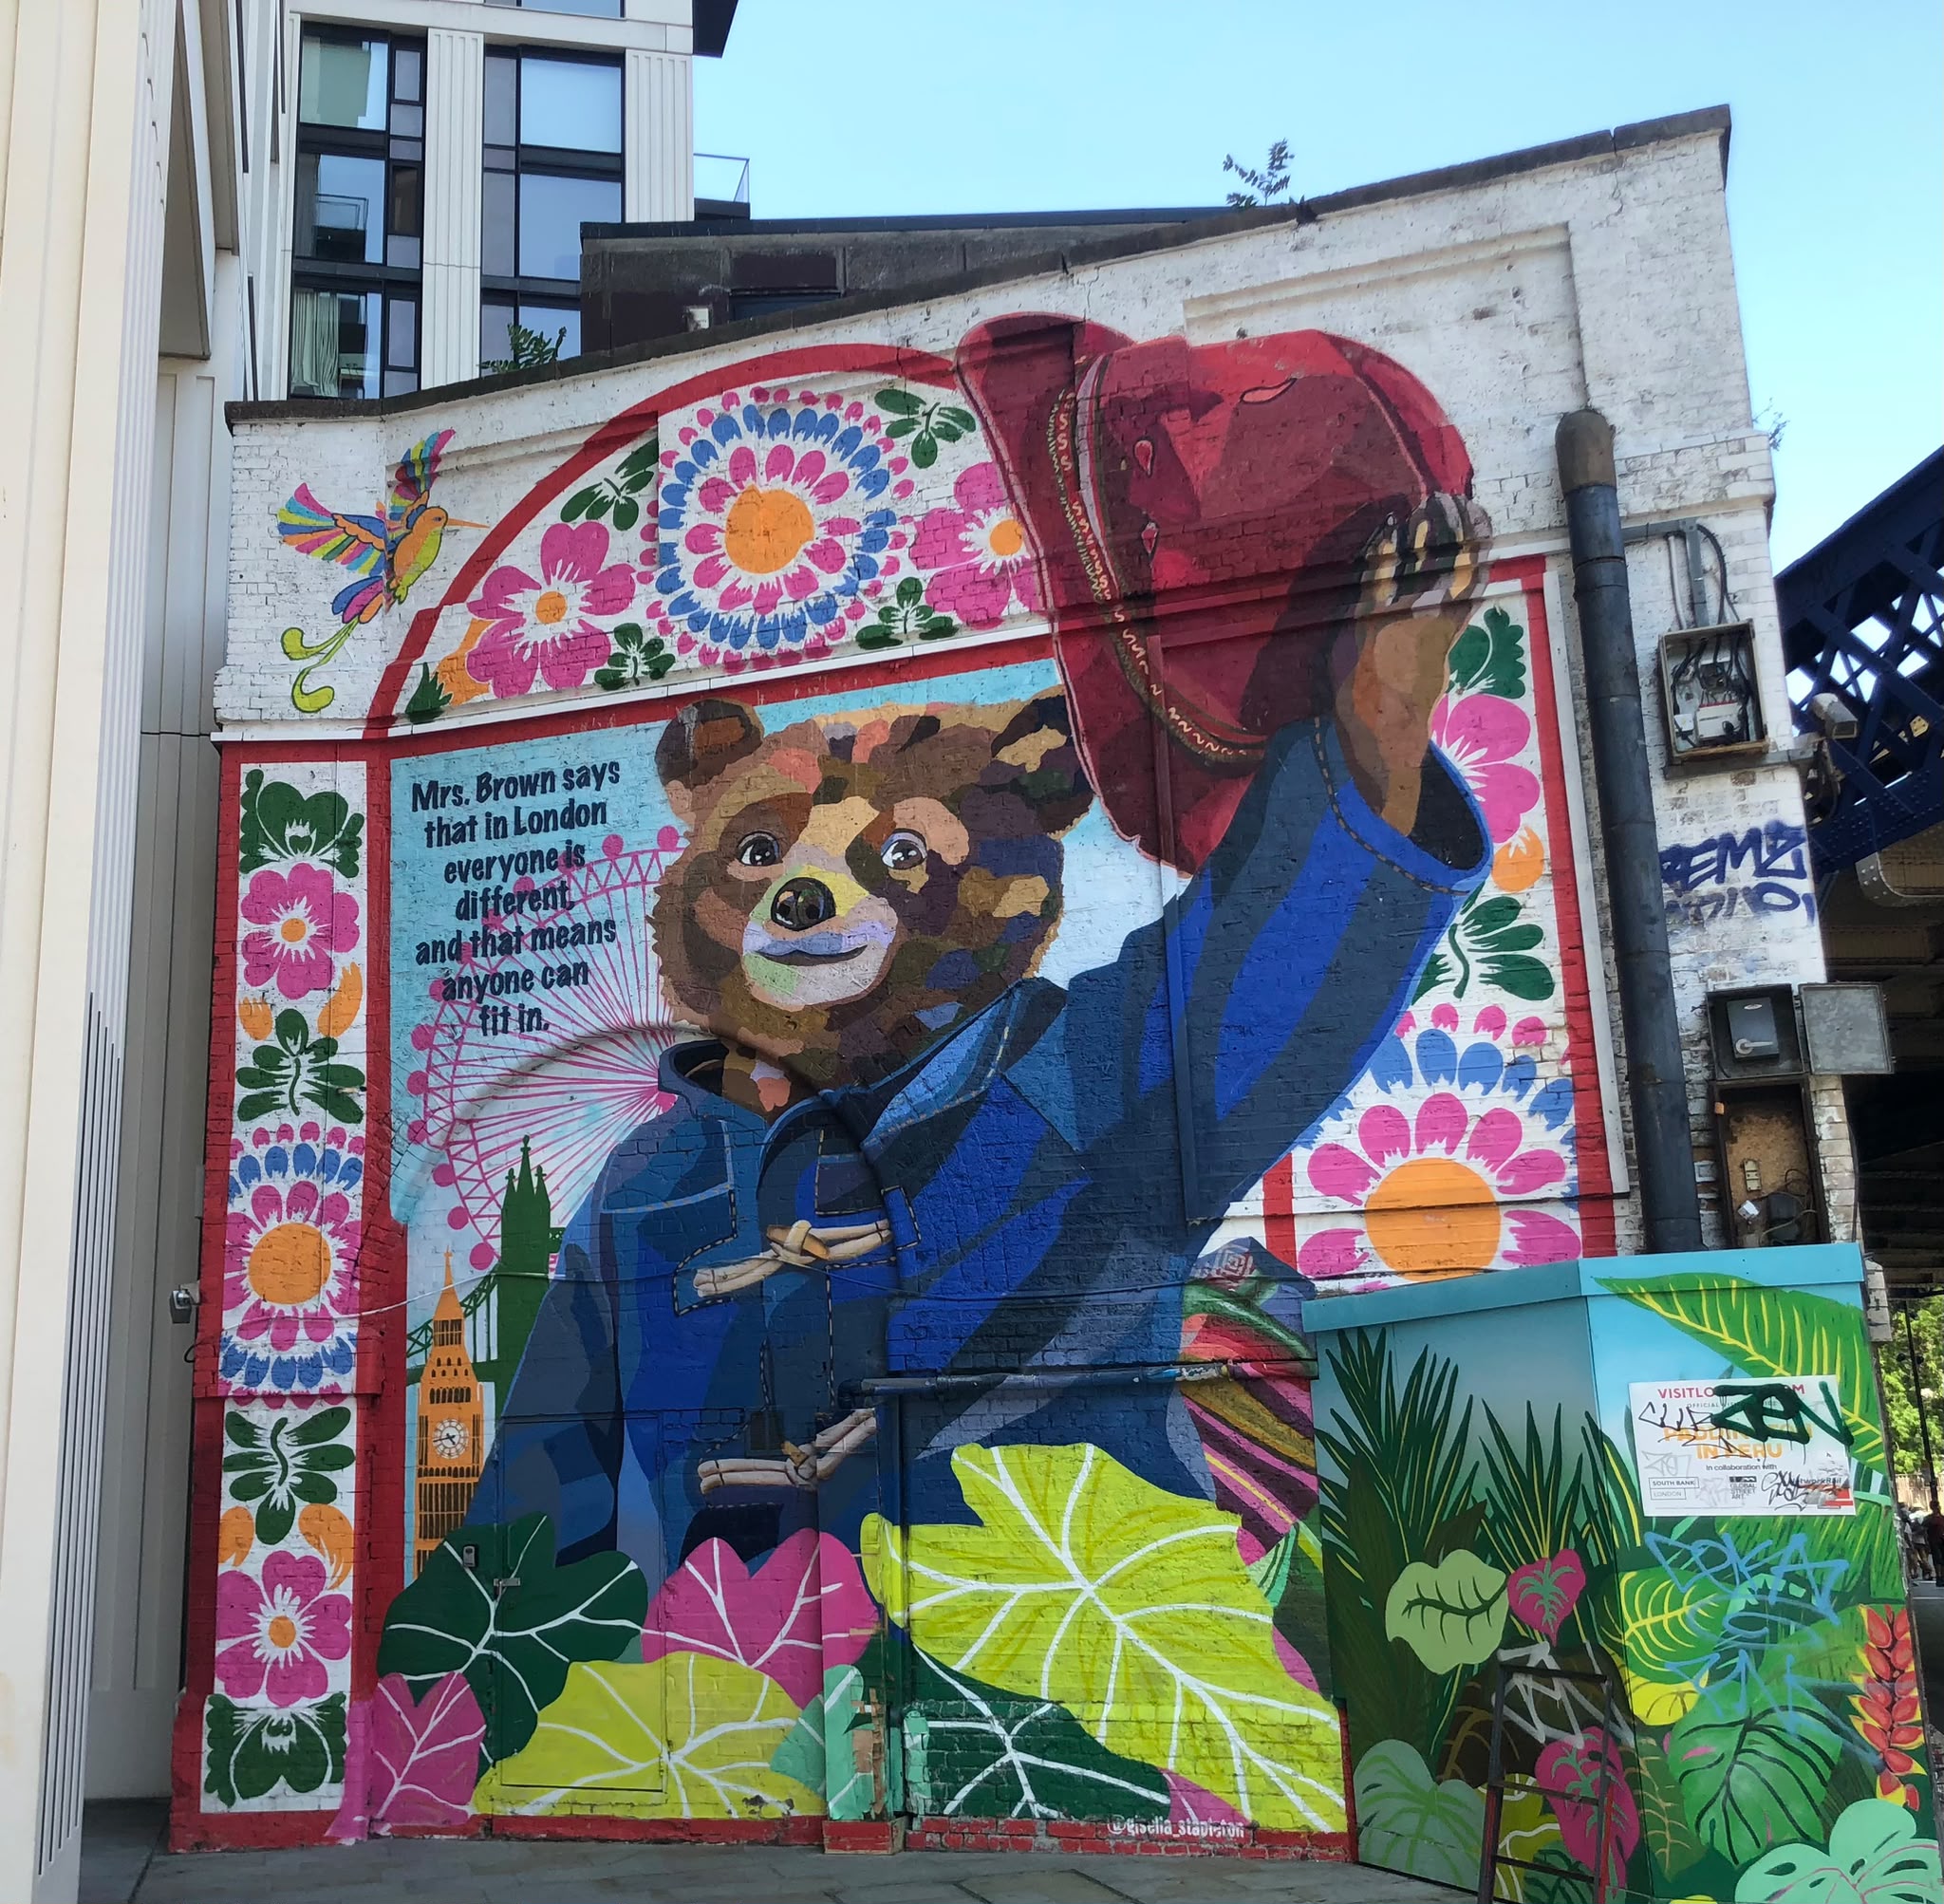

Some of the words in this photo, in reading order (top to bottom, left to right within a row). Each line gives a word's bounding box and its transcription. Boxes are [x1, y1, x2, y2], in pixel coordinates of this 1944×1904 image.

[412, 780, 471, 812] Mrs.
[476, 768, 556, 803] Brown
[562, 761, 621, 792] says
[424, 814, 478, 849] that
[485, 812, 509, 840] in
[514, 798, 608, 836] London
[444, 848, 559, 884] everyone
[566, 839, 586, 869] is
[416, 930, 462, 966] and
[469, 924, 525, 959] that
[531, 919, 616, 951] means
[441, 969, 534, 1003] anyone
[541, 960, 589, 987] can
[479, 1005, 513, 1036] fit
[518, 1003, 550, 1033] in.
[1696, 1445, 1718, 1460] IN
[1721, 1443, 1784, 1459] PERU
